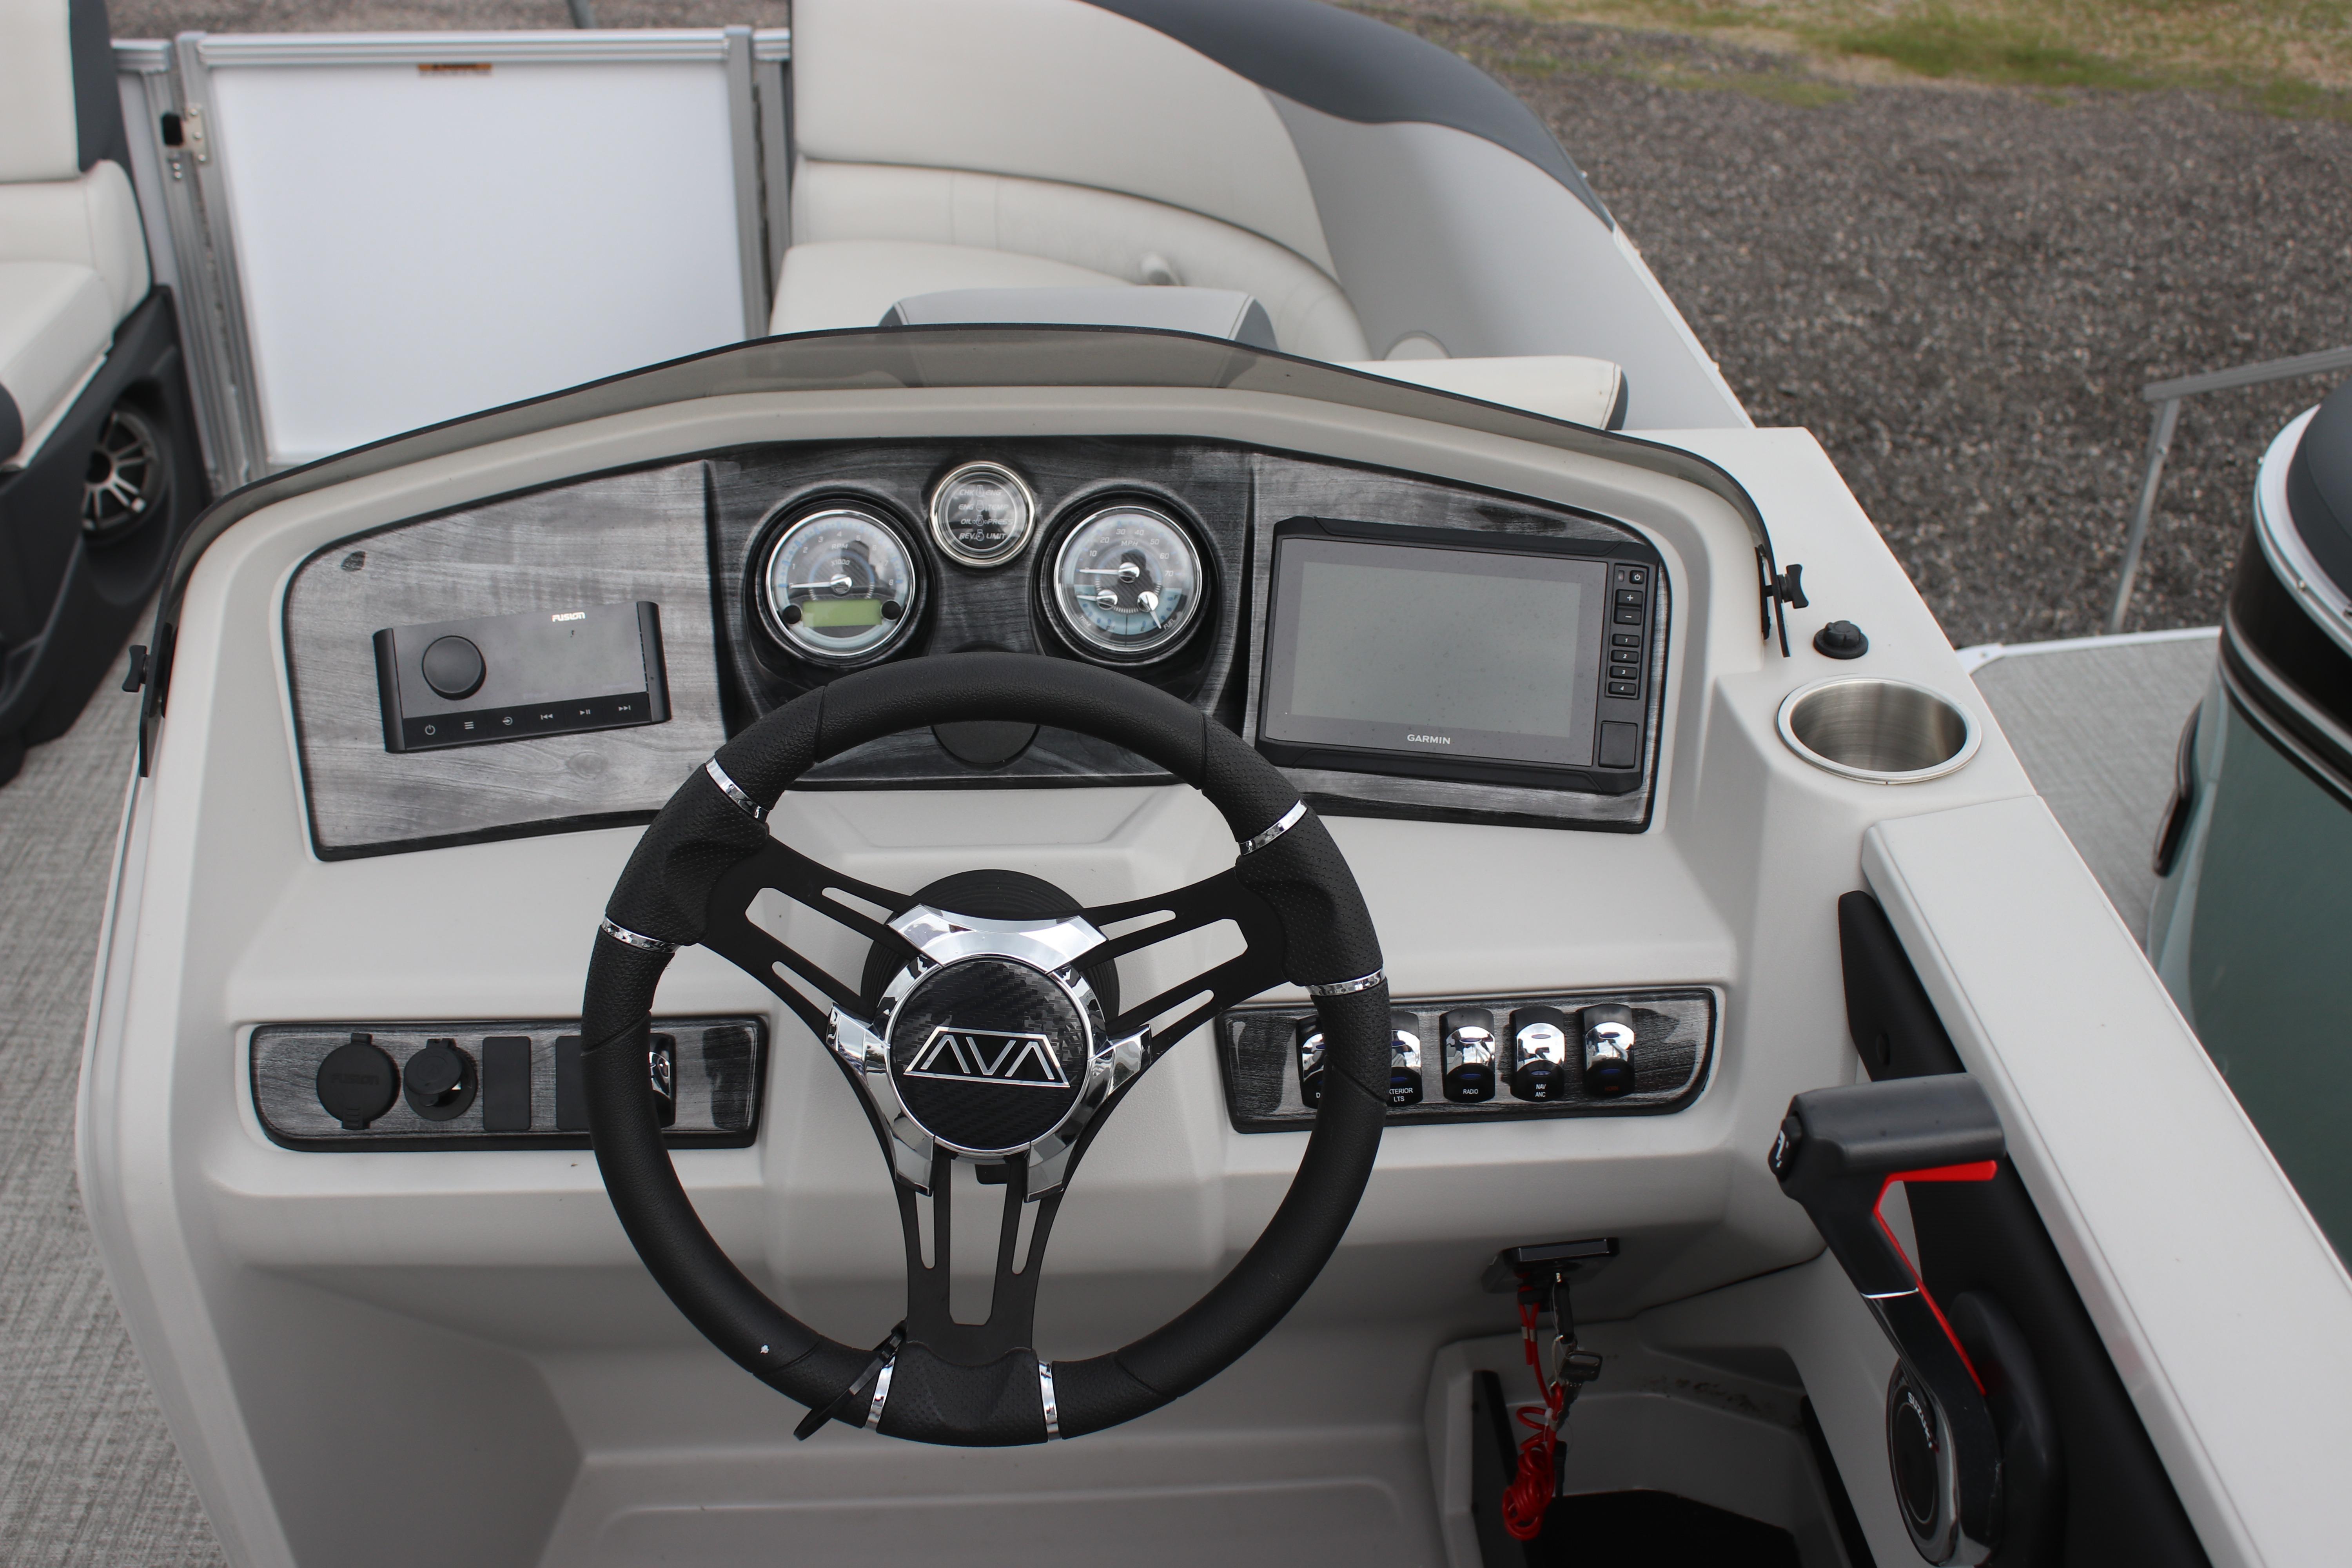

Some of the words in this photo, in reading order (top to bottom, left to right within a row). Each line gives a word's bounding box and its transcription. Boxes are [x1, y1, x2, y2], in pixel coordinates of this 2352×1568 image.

[552, 612, 586, 622] FUSION
[1079, 615, 1091, 627] TRIM
[1163, 618, 1176, 630] FUEL
[1407, 734, 1450, 744] GARMIN
[920, 1034, 1055, 1080] AVA
[331, 1073, 379, 1085] FUSION
[1908, 1392, 1932, 1448] SUZUKI
